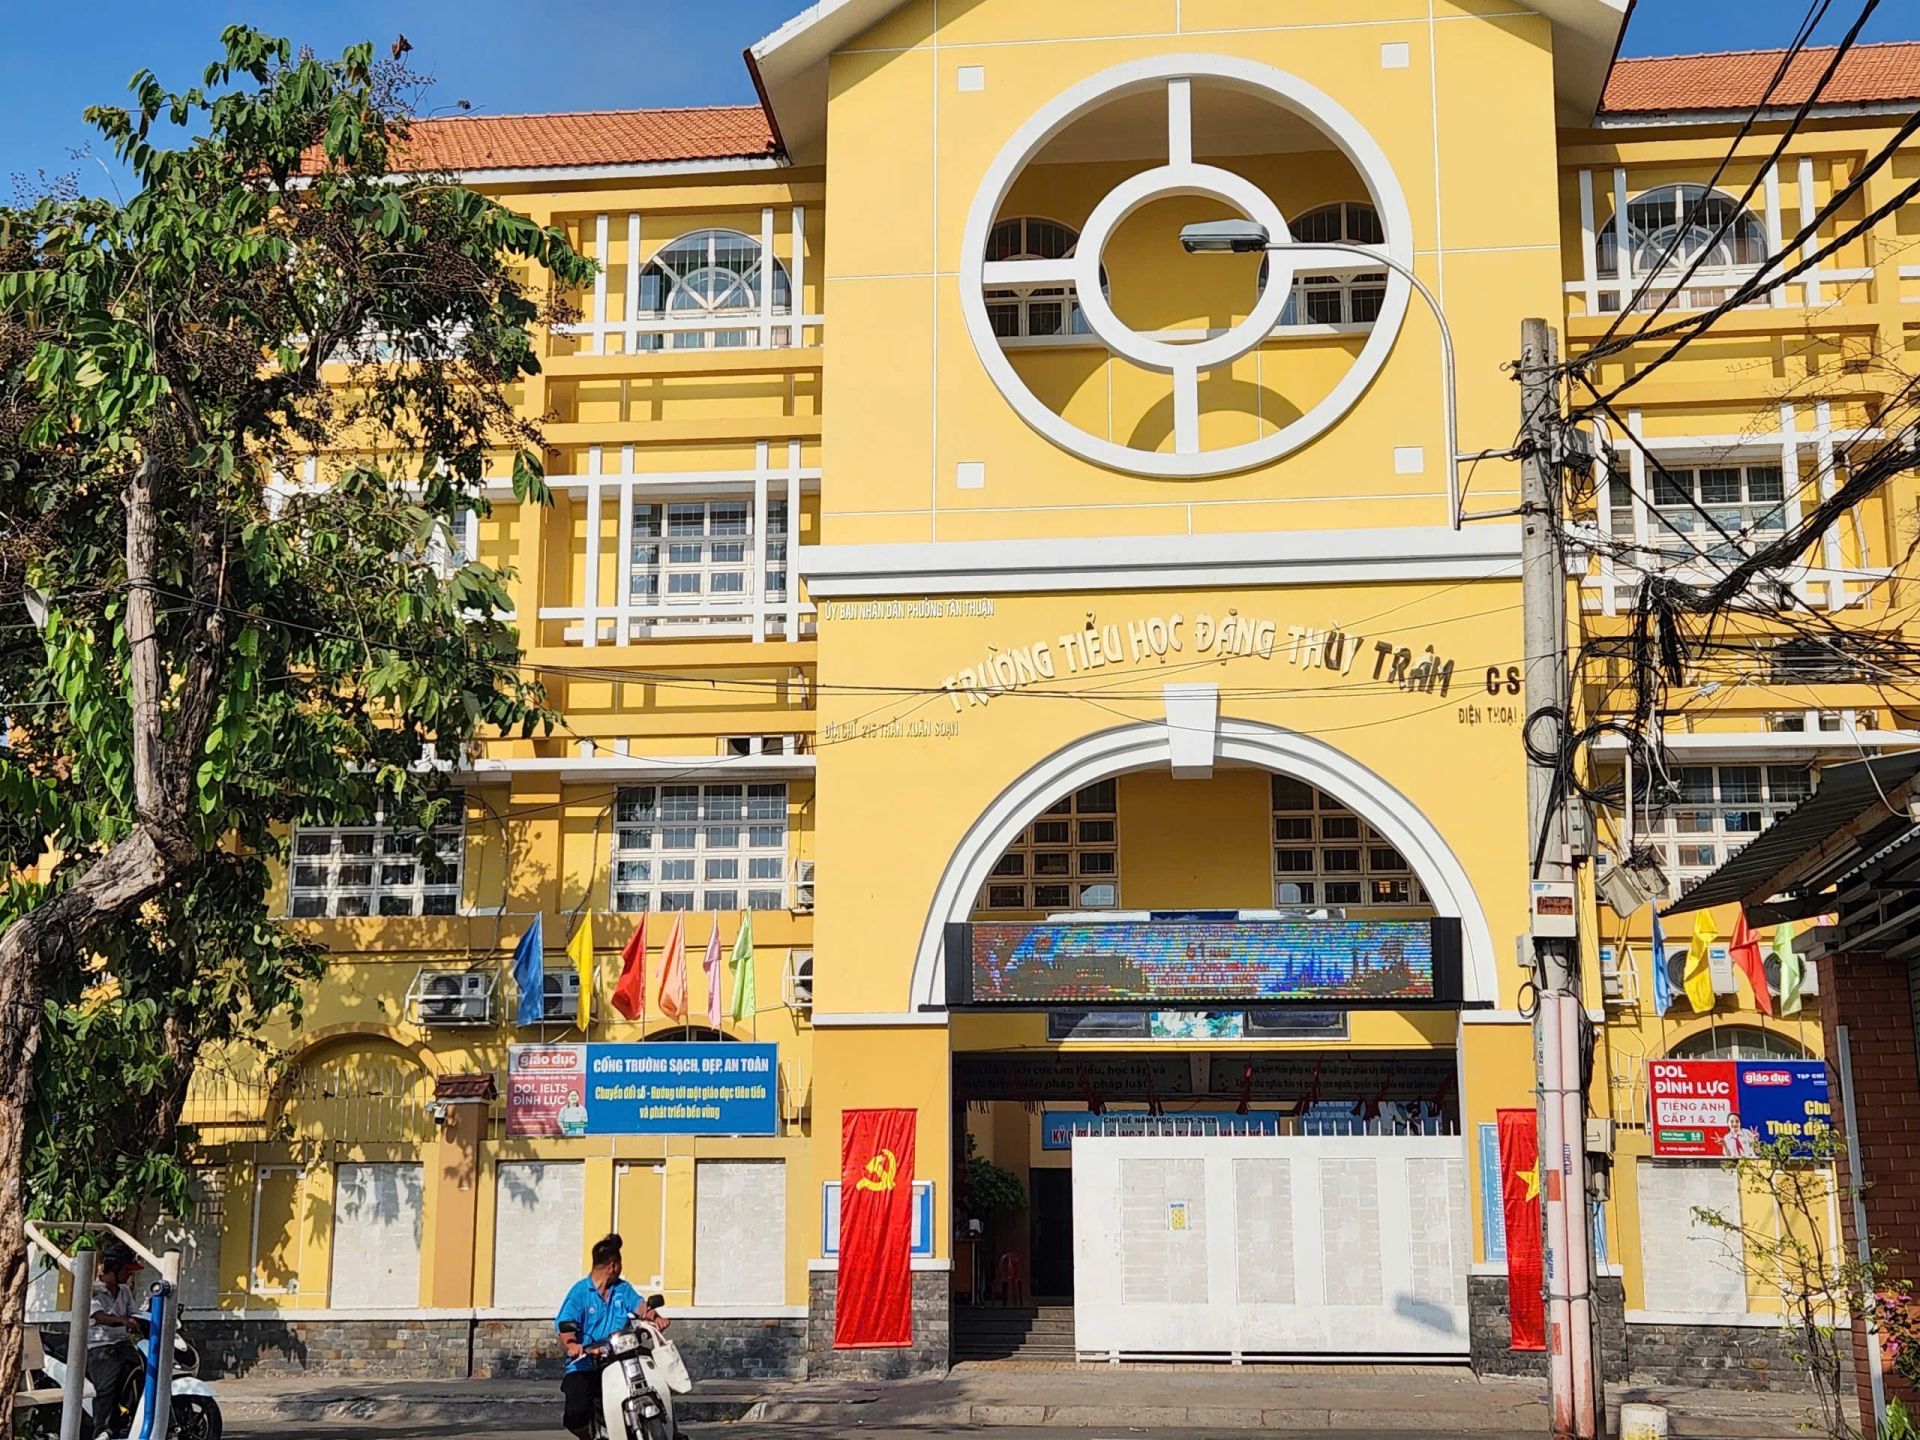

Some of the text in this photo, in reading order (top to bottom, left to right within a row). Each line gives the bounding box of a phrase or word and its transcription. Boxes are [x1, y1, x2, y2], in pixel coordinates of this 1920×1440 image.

[840, 603, 857, 619] BAN
[860, 600, 885, 620] NHÂN
[887, 600, 904, 619] DÂN
[939, 608, 1520, 713] TRƯỜNG TIỂU HỌC ĐẶNG THÙY TRÂM CS
[1458, 704, 1481, 726] ĐIỆN
[520, 1052, 576, 1068] giáo dục
[624, 1056, 667, 1073] TRƯỜNG
[669, 1058, 700, 1075] SẠCH,
[724, 1058, 739, 1072] AN
[741, 1055, 769, 1072] TOÀN
[1654, 1065, 1688, 1078] DOL
[1745, 1072, 1790, 1084] giáo dục
[514, 1083, 568, 1093] DOL IELTS
[1654, 1078, 1730, 1096] ĐÌNH LỰC
[512, 1094, 566, 1107] ĐÌNH LỰC
[1661, 1101, 1726, 1111] TIẾNG ANH
[1804, 1100, 1831, 1115] Chu
[1662, 1112, 1687, 1123] CẤP
[1697, 1115, 1705, 1123] &
[1709, 1115, 1717, 1124] 2
[1765, 1120, 1801, 1135] Thúc
